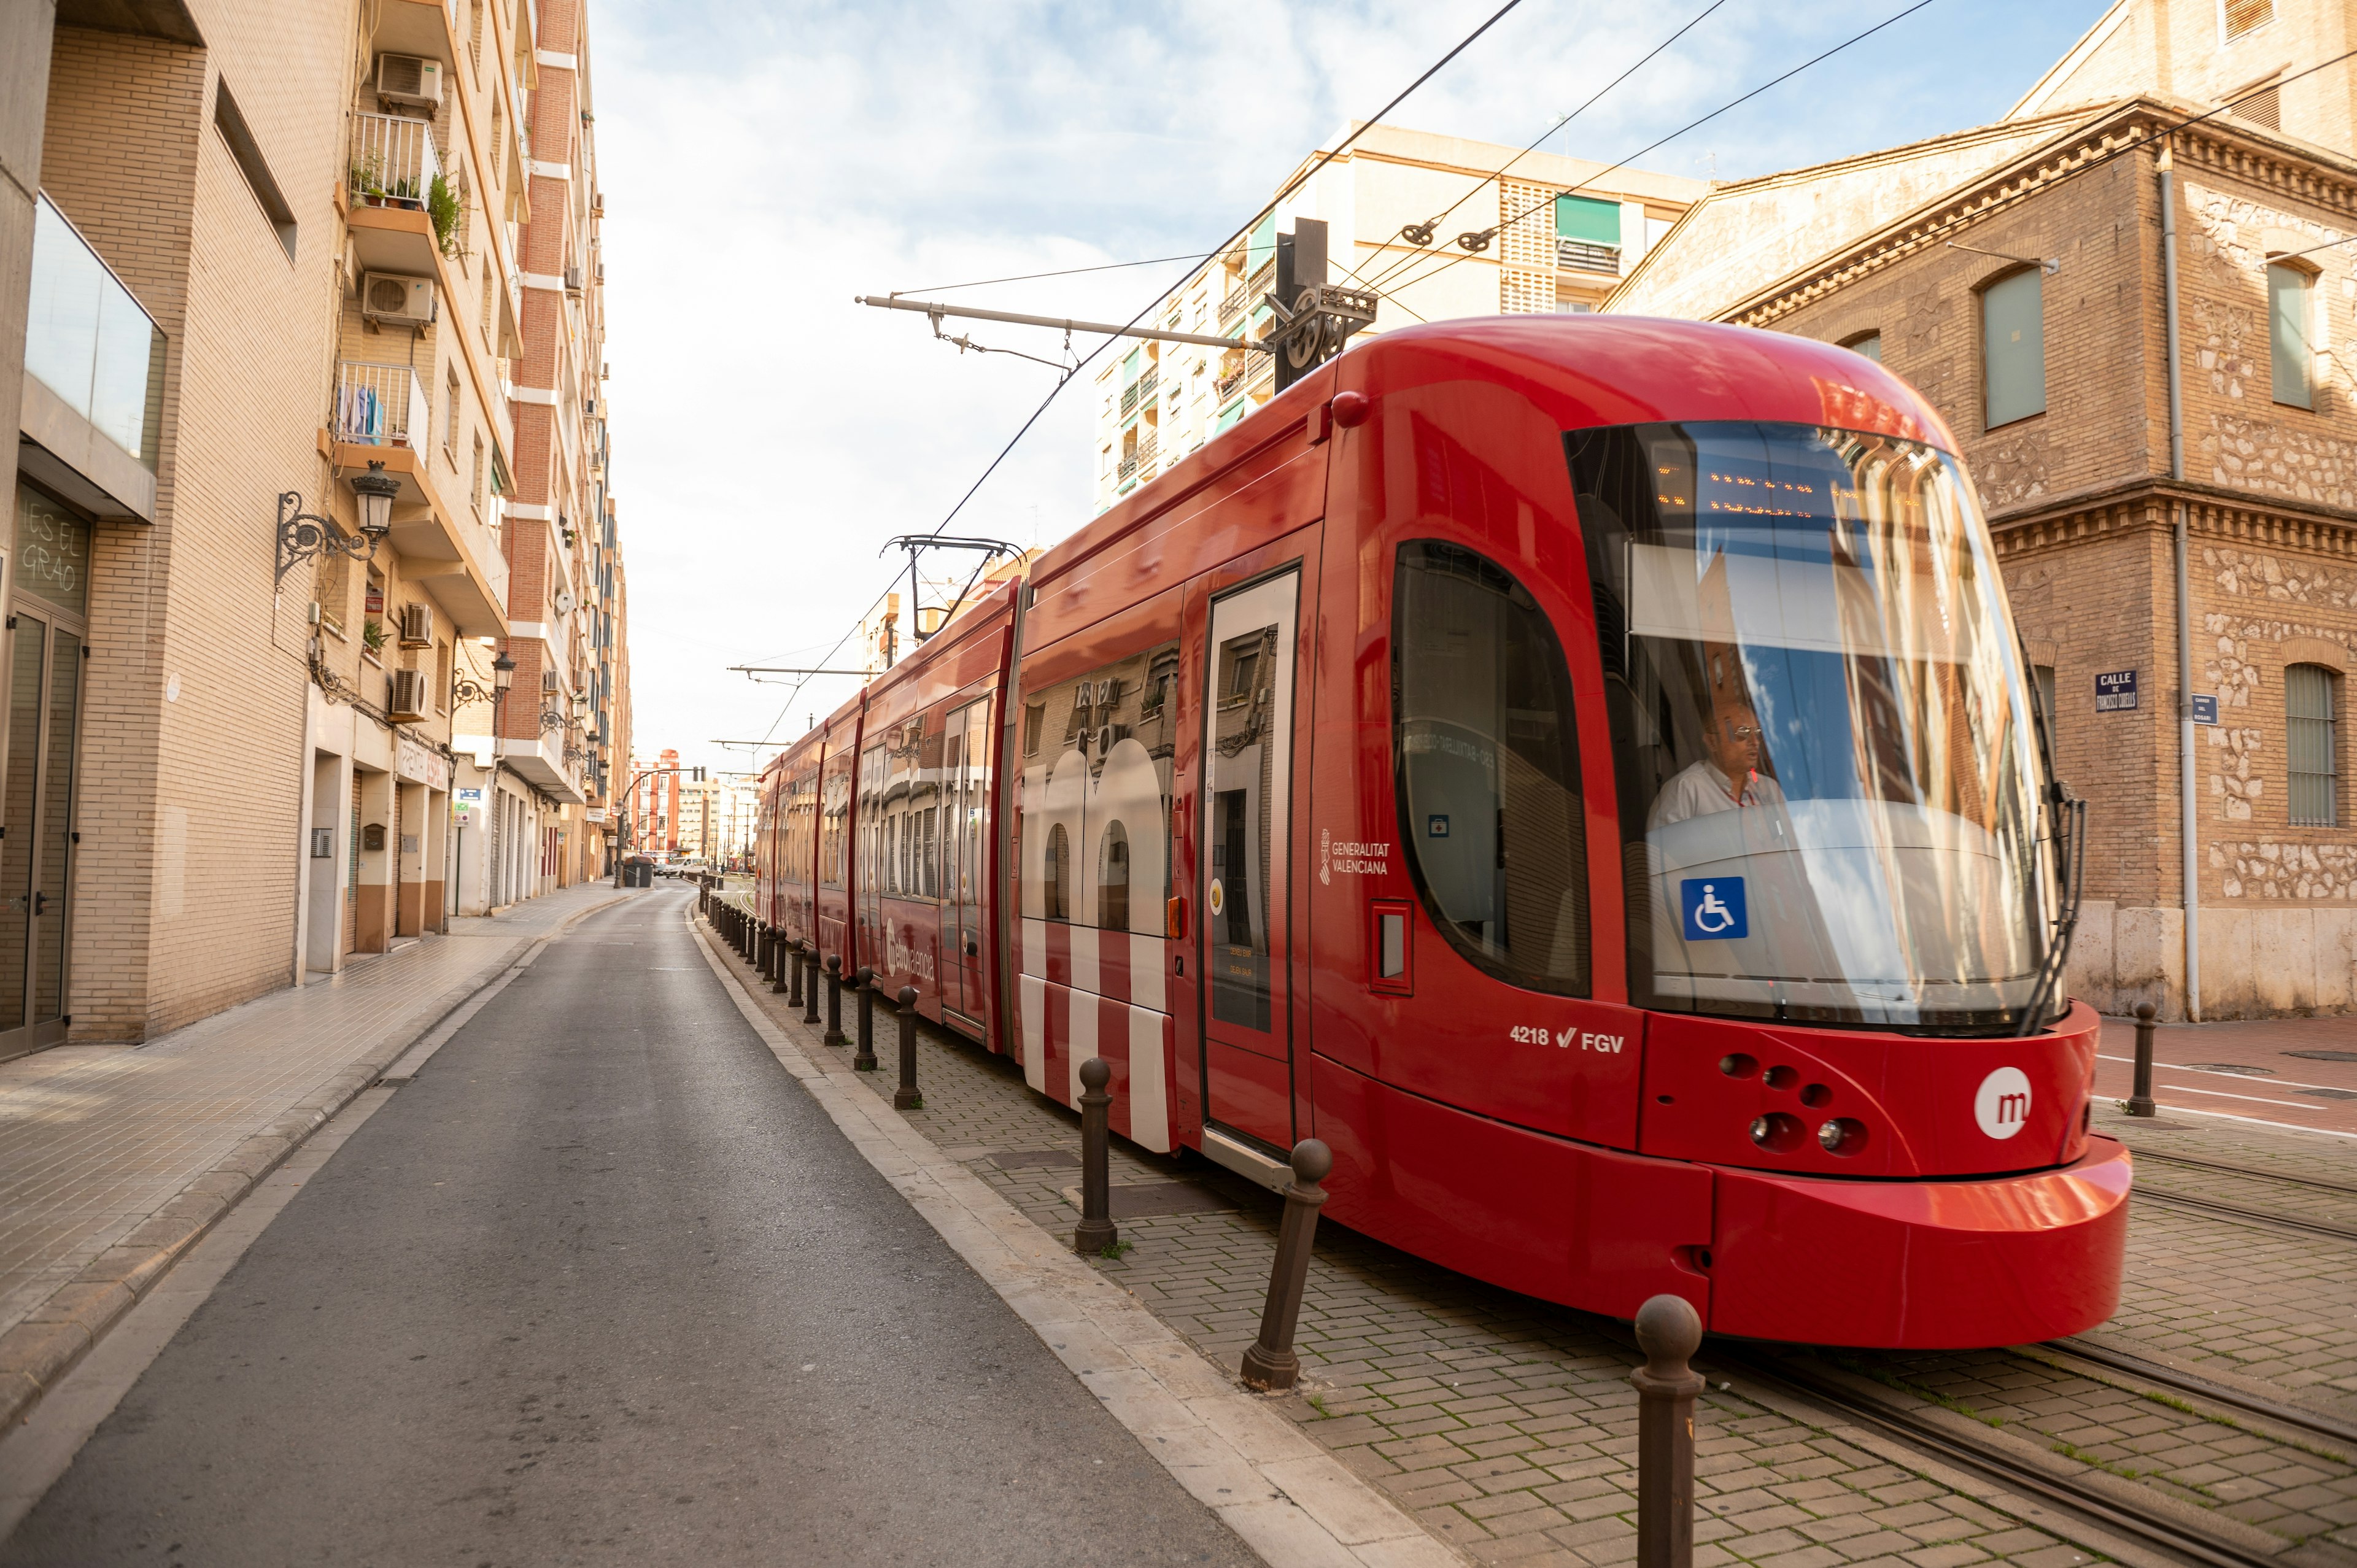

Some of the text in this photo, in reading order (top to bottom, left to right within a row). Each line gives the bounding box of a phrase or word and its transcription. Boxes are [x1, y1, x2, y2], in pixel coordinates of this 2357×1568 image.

[24, 500, 80, 557] IES EL
[23, 544, 75, 592] GRAO
[2100, 673, 2131, 686] CALLE
[2097, 694, 2118, 710] FRANCISCO
[1333, 842, 1390, 857] GENERALITAT
[1333, 859, 1388, 875] VALENCIANA
[889, 938, 934, 981] metrovalencia
[1509, 1025, 1625, 1054] 4218 FGV
